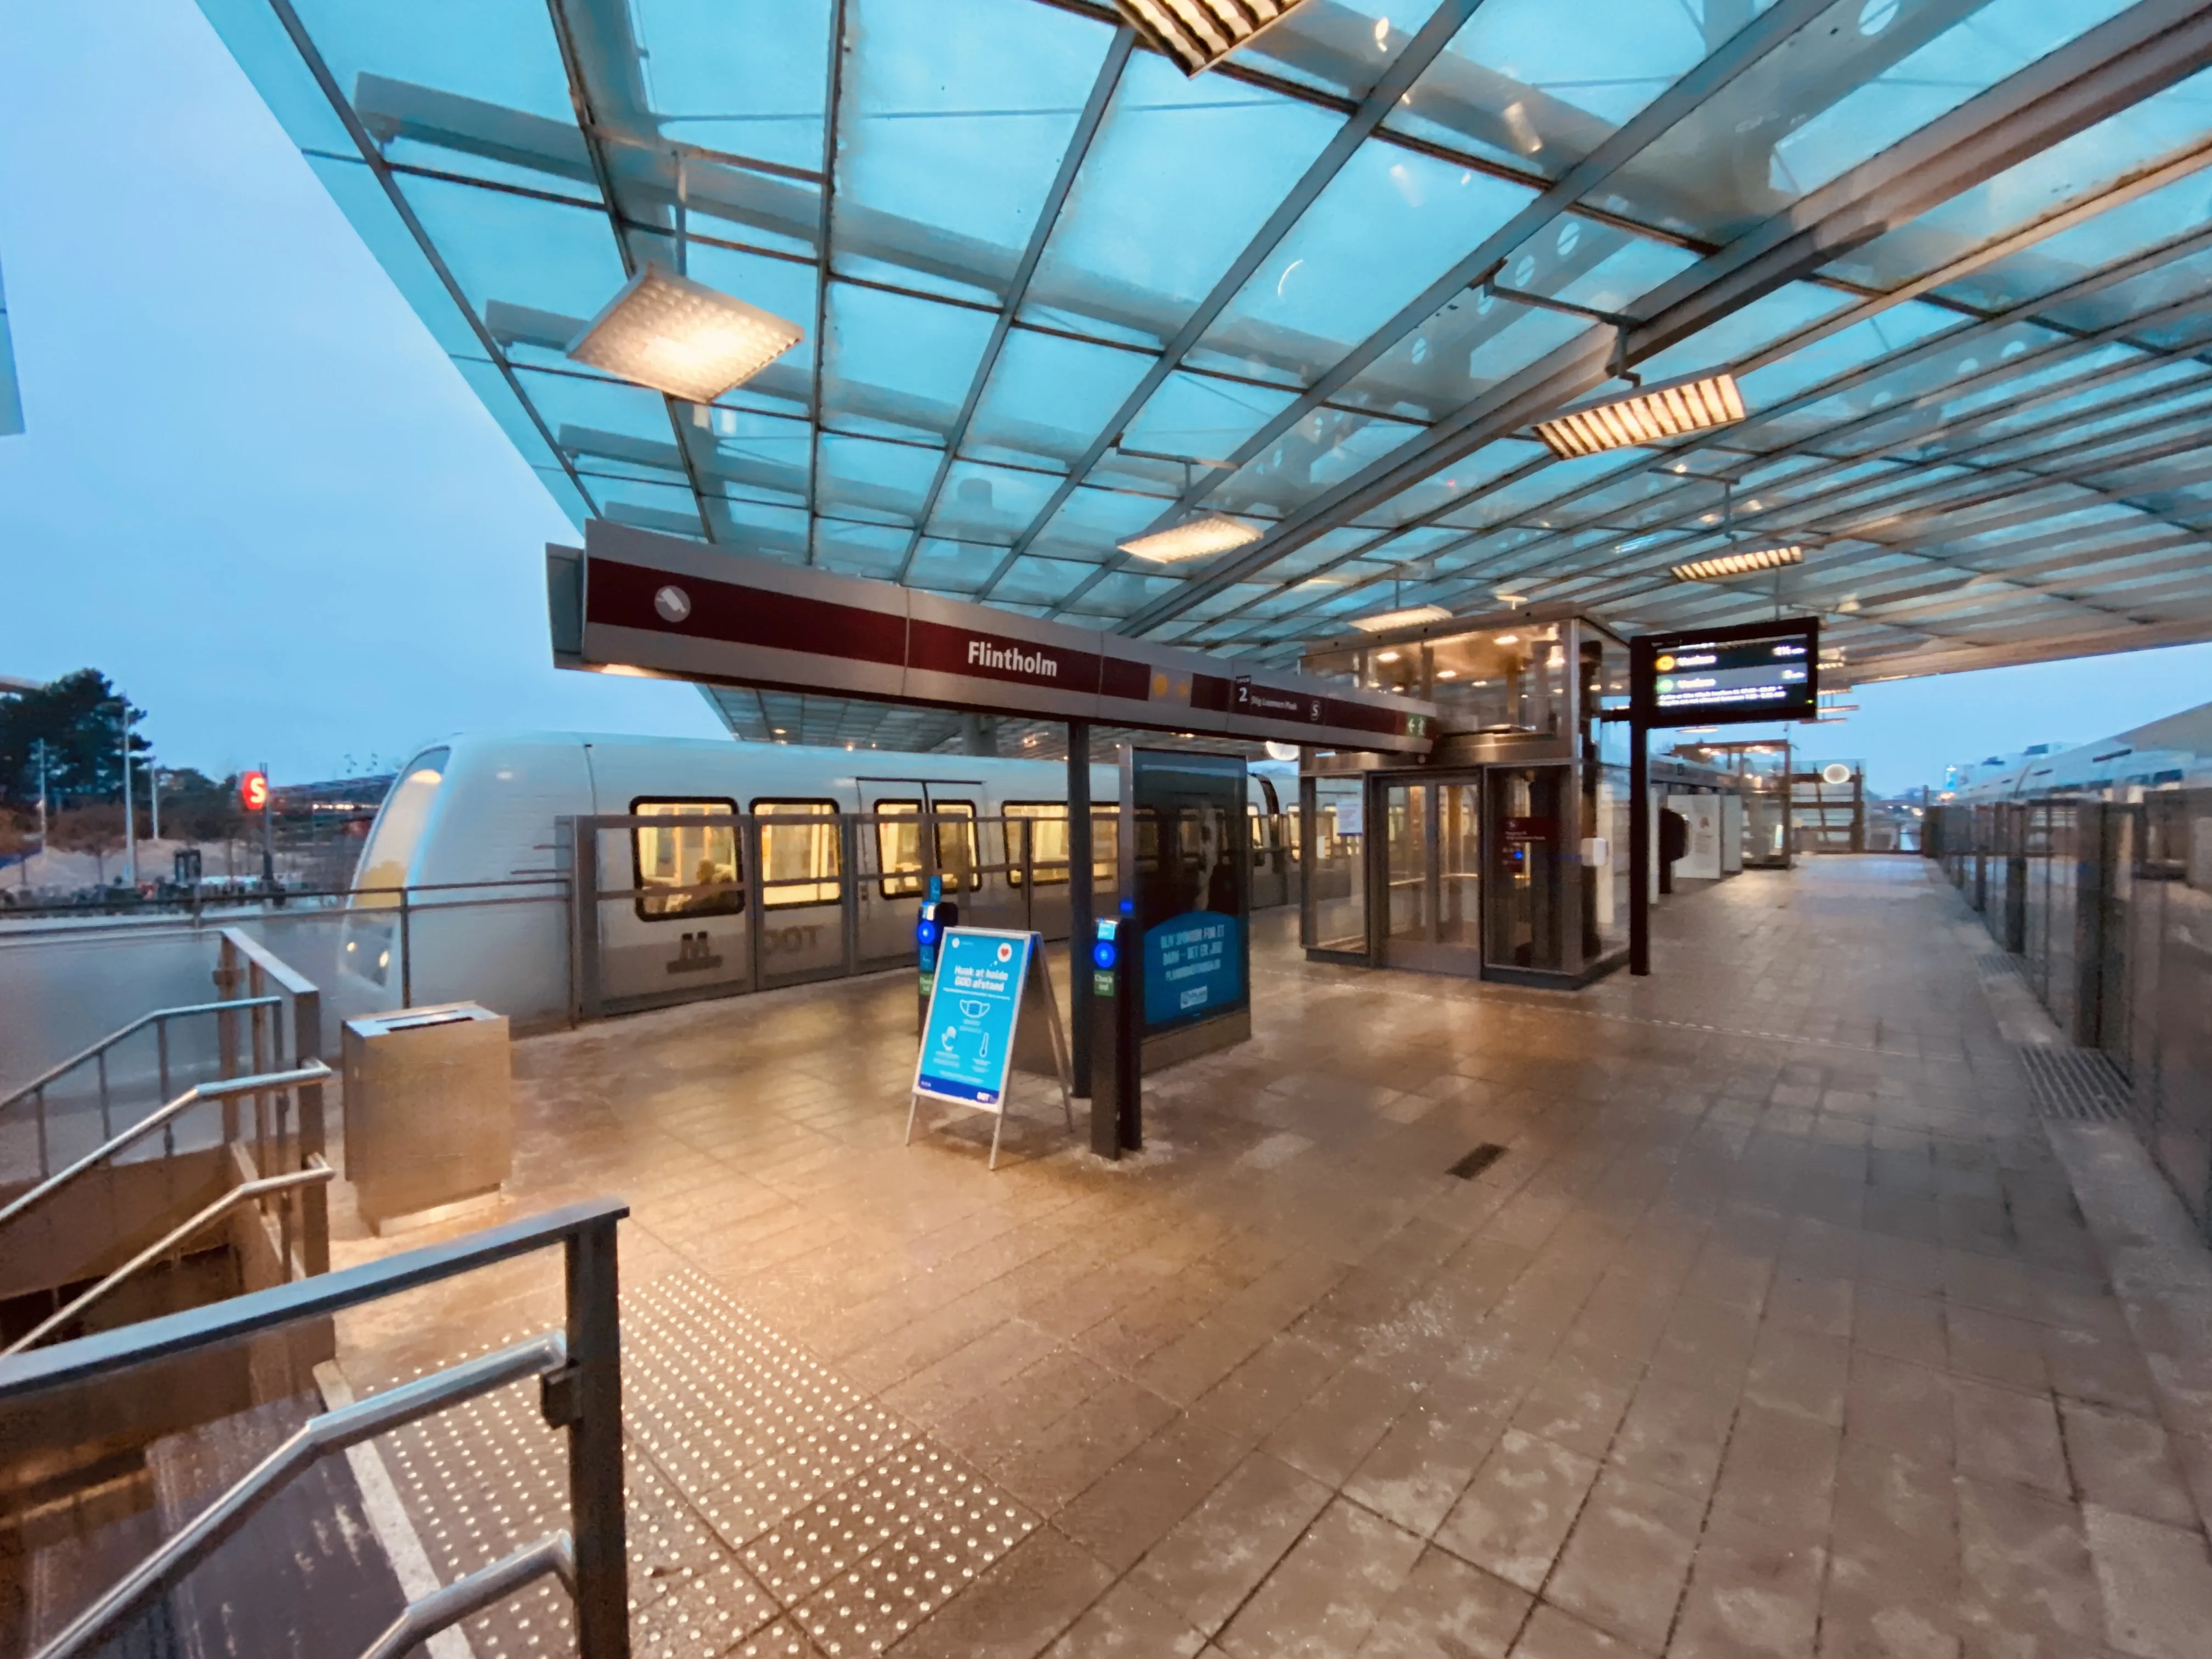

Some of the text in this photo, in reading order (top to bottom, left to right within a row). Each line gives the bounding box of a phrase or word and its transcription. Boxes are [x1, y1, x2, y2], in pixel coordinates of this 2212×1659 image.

[968, 641, 1058, 676] Flintholm
[1239, 687, 1248, 702] 2
[251, 777, 266, 804] S
[955, 965, 1008, 981] Husk at holde
